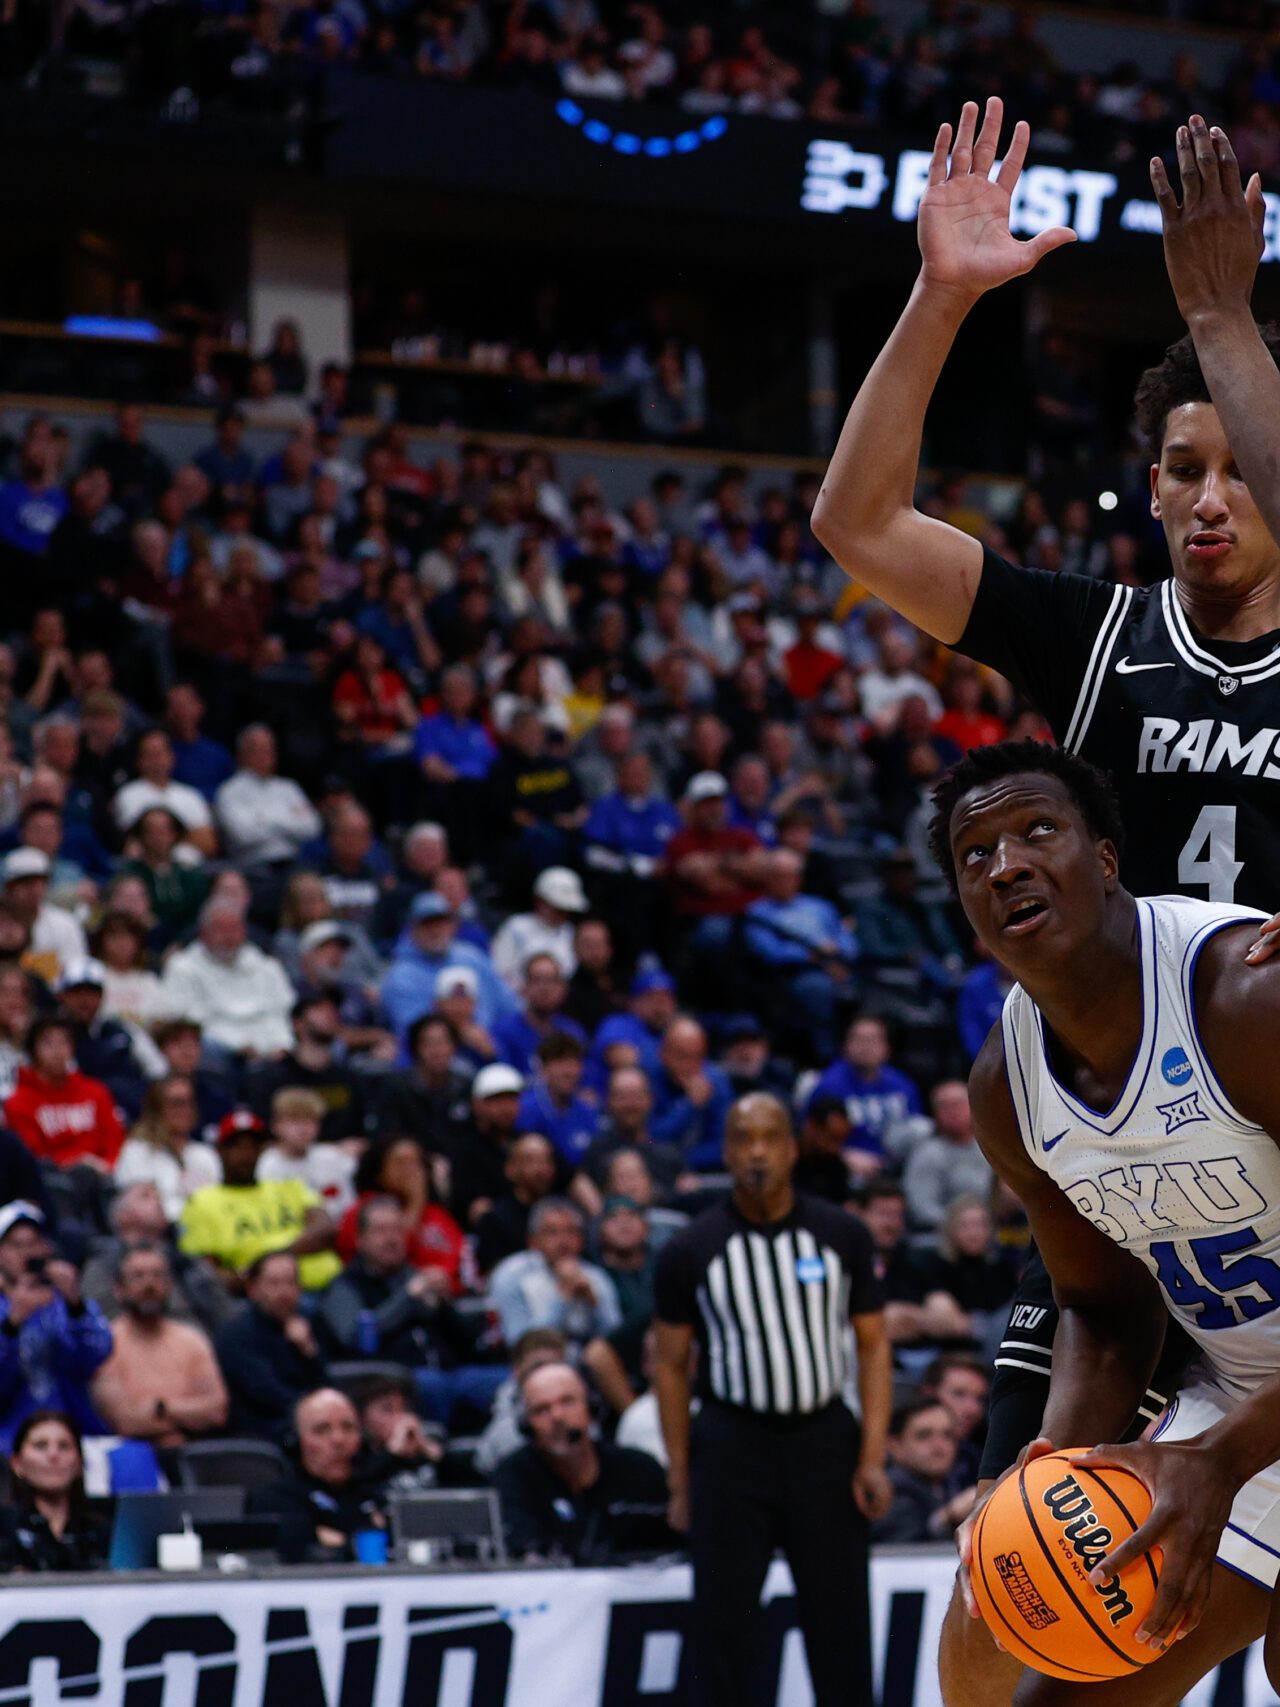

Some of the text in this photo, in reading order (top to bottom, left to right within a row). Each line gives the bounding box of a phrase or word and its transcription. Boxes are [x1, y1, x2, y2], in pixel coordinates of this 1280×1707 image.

[1176, 804, 1245, 904] 4
[1063, 1156, 1268, 1244] BYU
[1008, 1304, 1049, 1330] VCU
[1057, 1538, 1087, 1582] EVO NXT
[1005, 1575, 1048, 1630] MADNESS
[1012, 1564, 1043, 1607] MARCH
